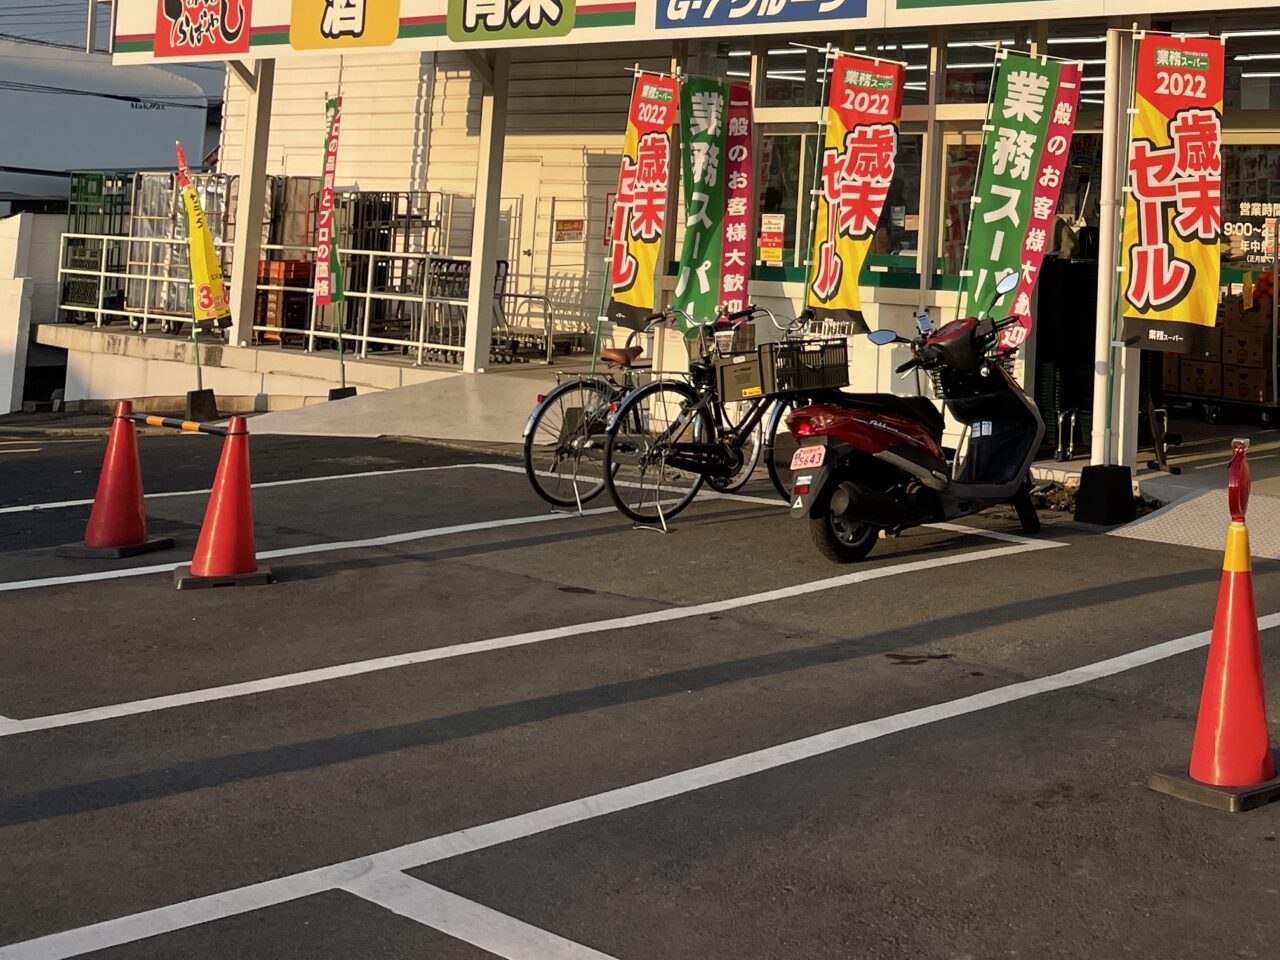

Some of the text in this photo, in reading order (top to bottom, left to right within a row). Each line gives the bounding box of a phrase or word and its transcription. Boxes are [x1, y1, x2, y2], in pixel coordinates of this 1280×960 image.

[840, 89, 890, 116] 2022
[844, 70, 894, 89] 業務スーパー
[1153, 71, 1208, 99] 2022
[1156, 48, 1208, 68] 業務スーパー
[637, 102, 669, 125] 2022
[630, 132, 670, 240] 歳末
[675, 91, 724, 328] 業務スーパー
[839, 123, 899, 238] 歳末
[974, 70, 1051, 321] 業務スーパ
[1126, 140, 1191, 308] セール
[1171, 109, 1221, 239] 歳末
